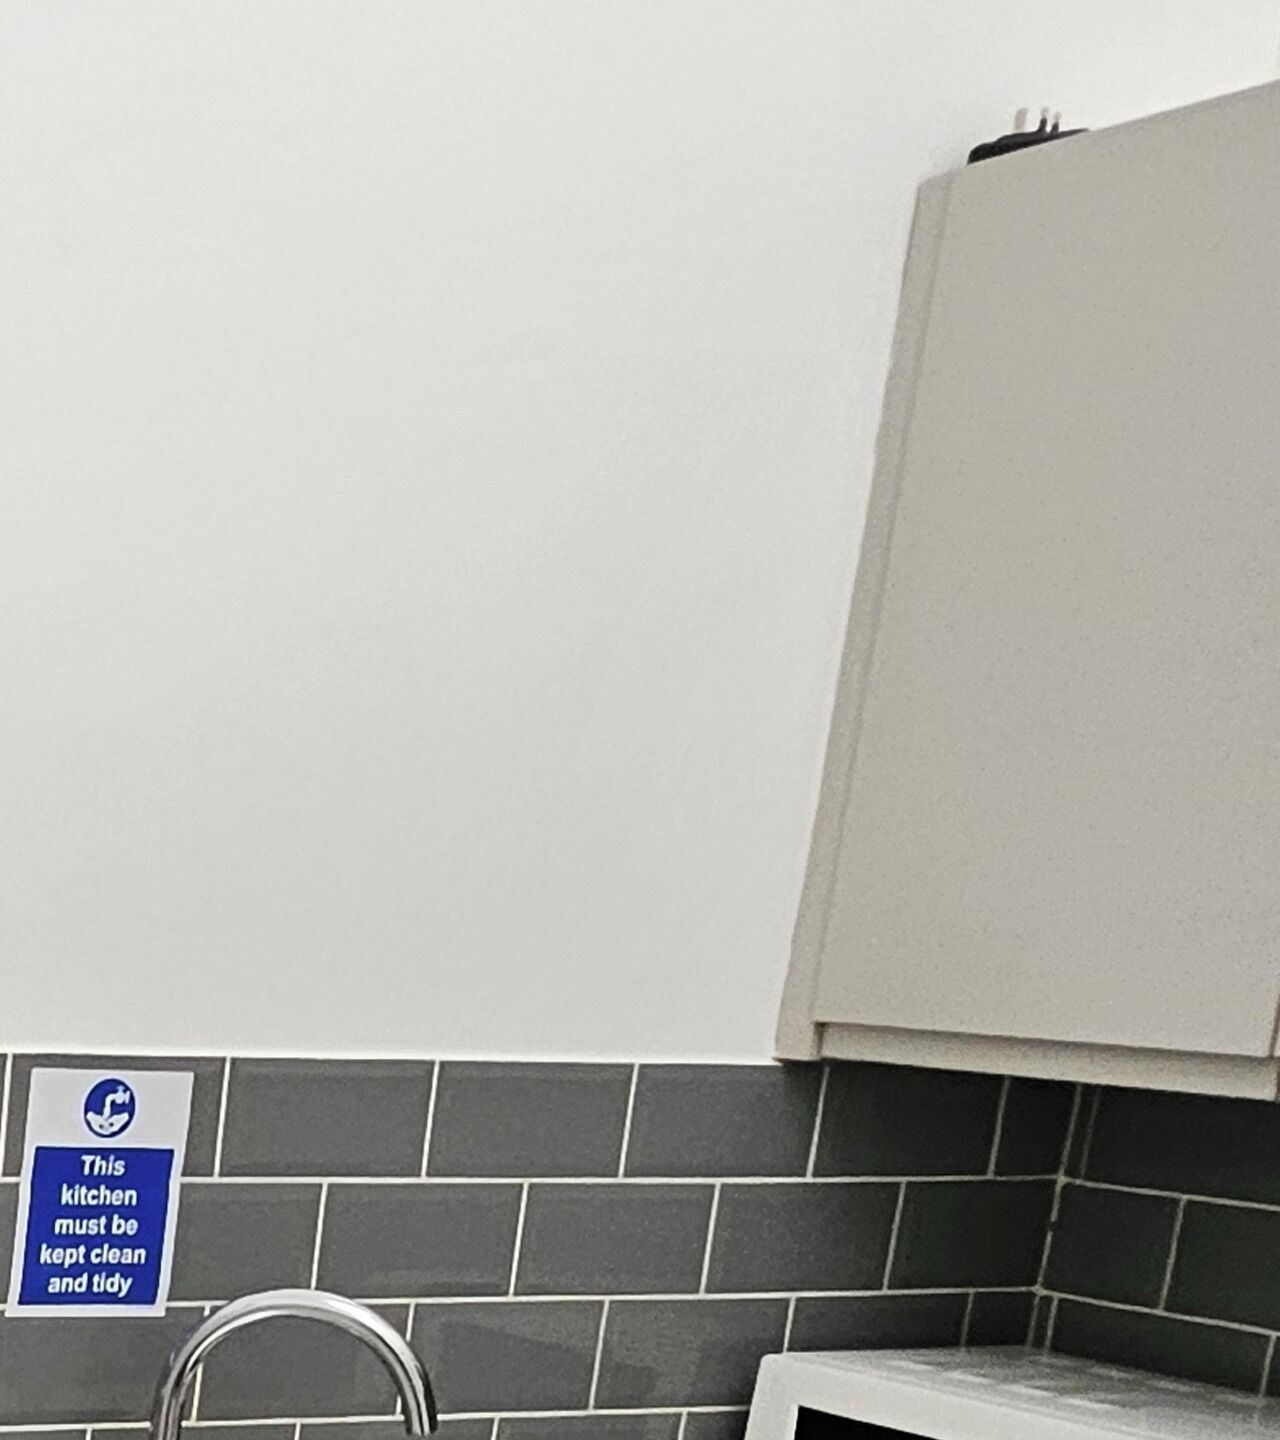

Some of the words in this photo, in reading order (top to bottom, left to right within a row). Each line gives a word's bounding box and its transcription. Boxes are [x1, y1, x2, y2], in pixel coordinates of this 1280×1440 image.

[80, 1155, 126, 1176] This
[60, 1184, 138, 1206] kitchen
[54, 1215, 107, 1235] must
[111, 1214, 139, 1235] be
[39, 1243, 86, 1269] kept
[90, 1244, 147, 1264] clean
[47, 1272, 89, 1293] and
[92, 1273, 134, 1298] tidy
